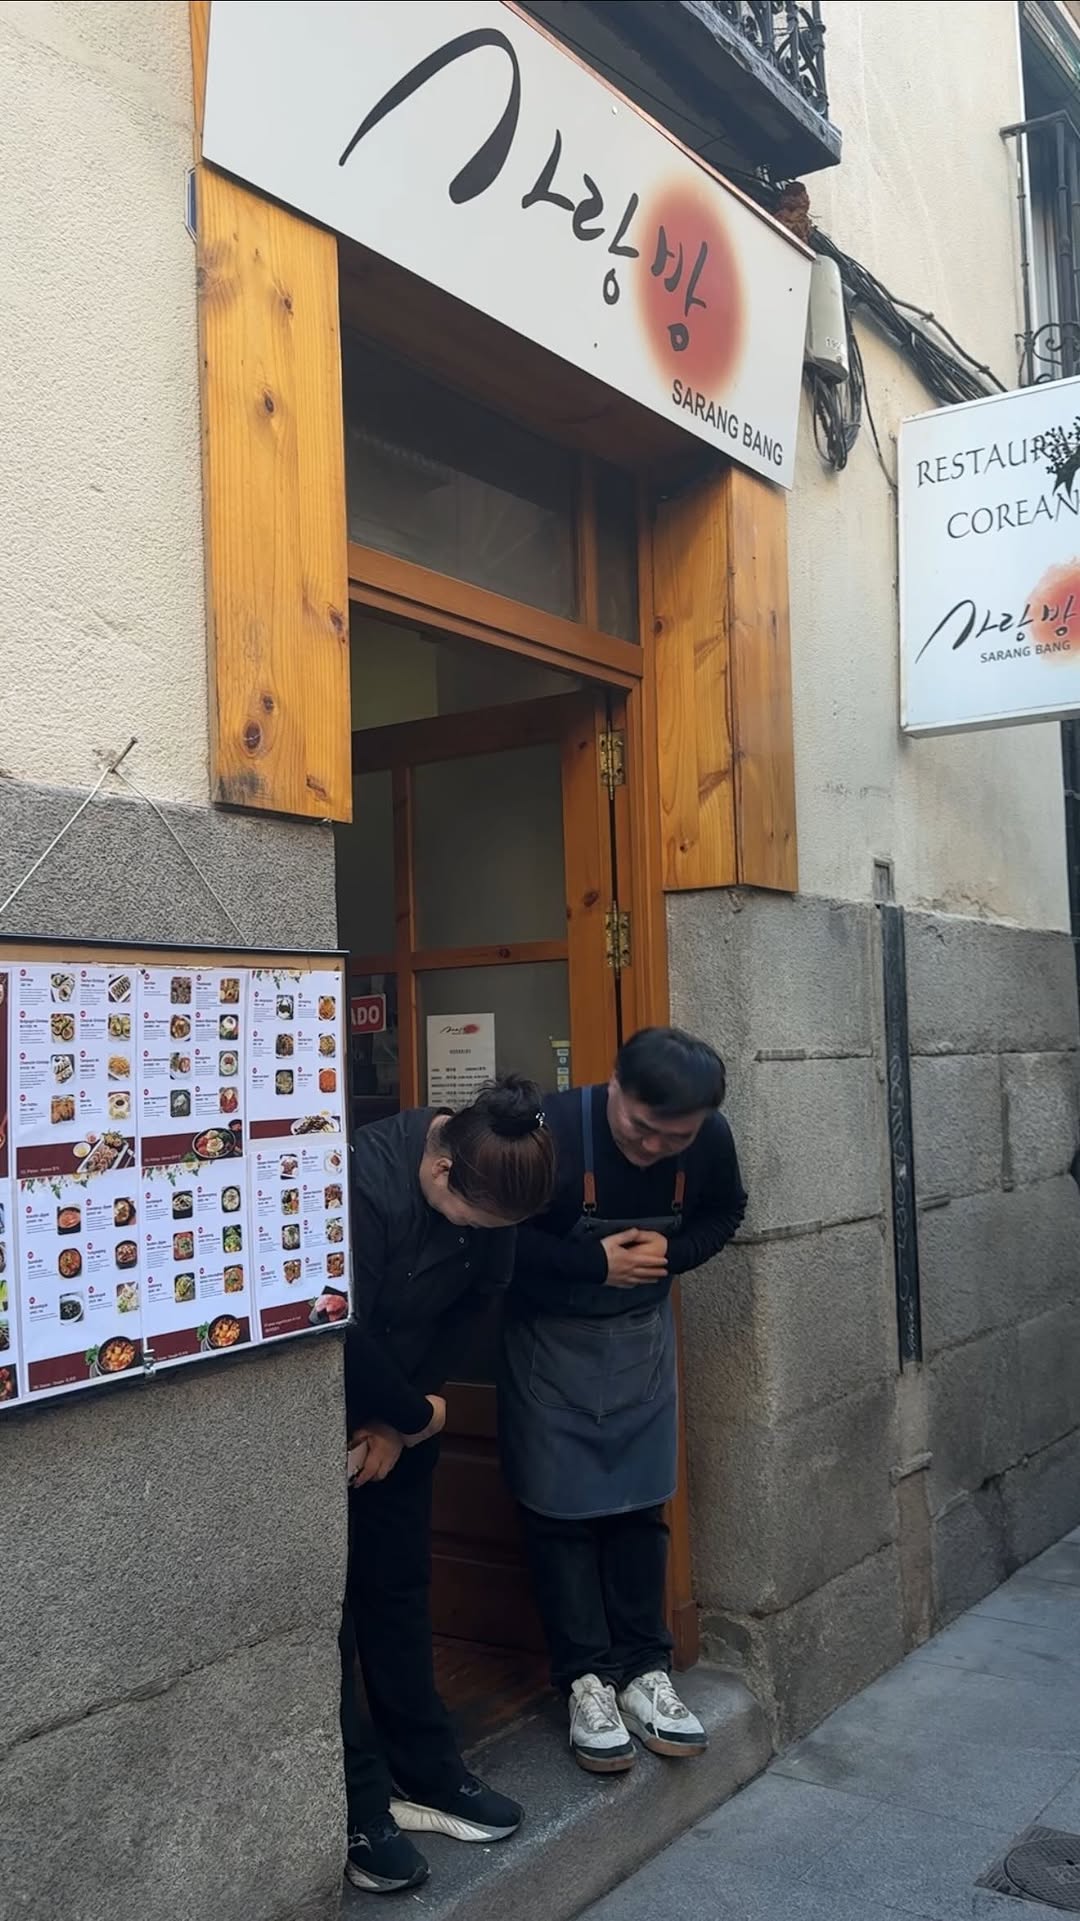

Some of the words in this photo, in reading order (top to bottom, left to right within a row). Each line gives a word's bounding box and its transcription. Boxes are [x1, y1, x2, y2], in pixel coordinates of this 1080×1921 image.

[338, 27, 708, 352] 사랑방
[671, 378, 739, 440] SARANG
[742, 421, 784, 467] BANG
[914, 594, 1078, 664] 사랑방
[979, 645, 1032, 664] SARANG
[1035, 639, 1072, 656] BANG
